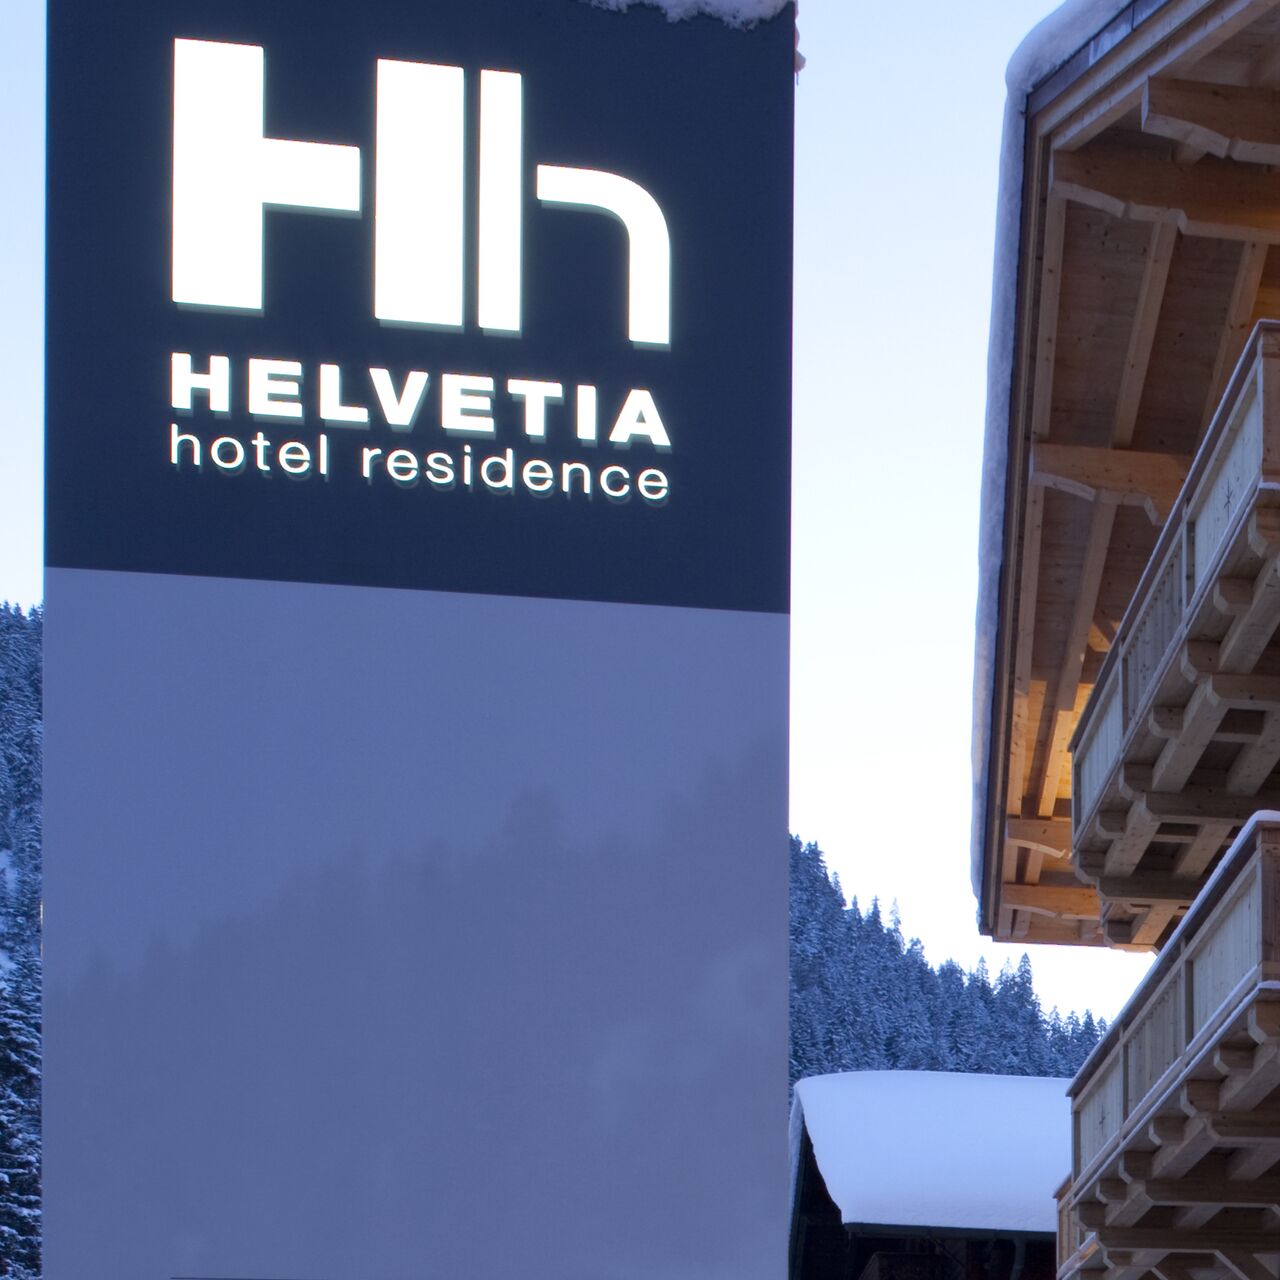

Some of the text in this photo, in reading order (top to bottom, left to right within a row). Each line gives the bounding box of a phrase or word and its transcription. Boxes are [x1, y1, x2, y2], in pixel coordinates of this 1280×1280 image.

[171, 352, 671, 447] HELVETIA
[170, 424, 670, 501] hotel residence
